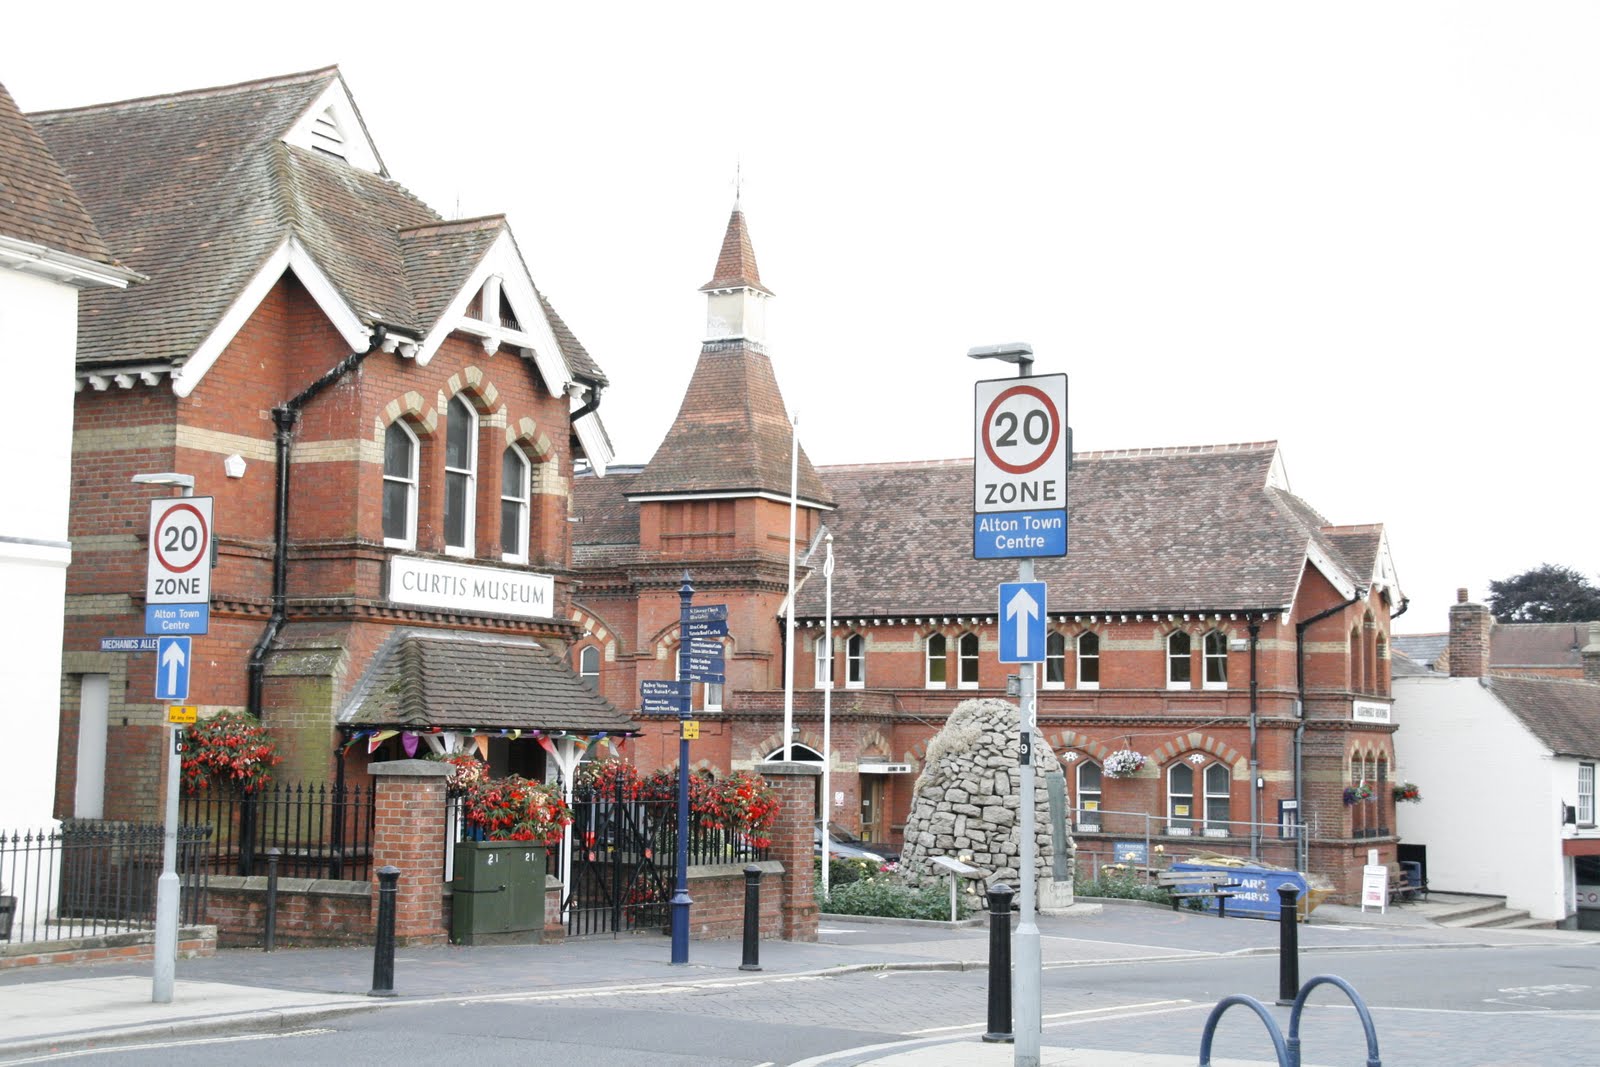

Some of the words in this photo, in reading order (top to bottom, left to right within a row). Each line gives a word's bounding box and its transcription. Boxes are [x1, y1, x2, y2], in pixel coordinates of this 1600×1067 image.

[995, 409, 1049, 448] 20
[984, 480, 1056, 505] ZONE
[979, 518, 1018, 532] Alton
[1023, 515, 1061, 530] Town
[164, 525, 198, 552] 20
[995, 535, 1045, 549] Centre
[155, 578, 200, 595] ZONE
[402, 571, 467, 596] CURTIS
[472, 579, 544, 604] MUSEUM
[154, 609, 176, 619] Alton
[179, 608, 200, 618] Town
[162, 620, 190, 630] Centre
[102, 640, 139, 649] MECHANICS
[1020, 744, 1028, 755] 9
[488, 853, 499, 865] 21
[525, 852, 535, 862] 21
